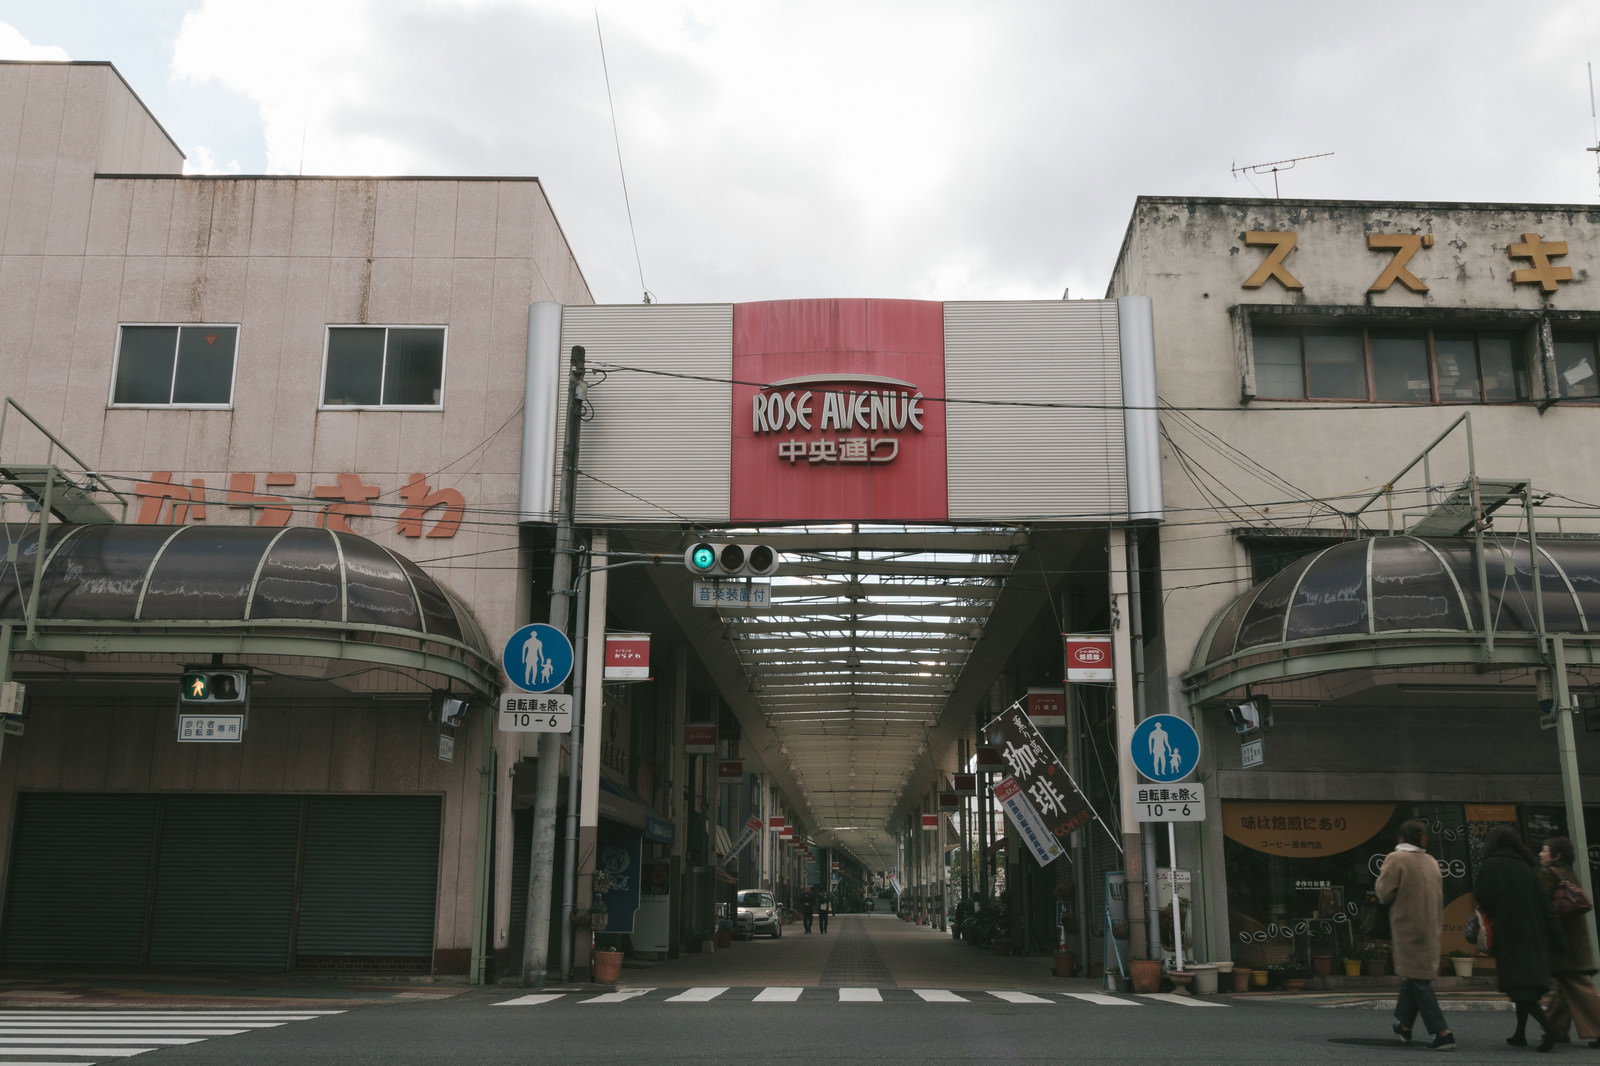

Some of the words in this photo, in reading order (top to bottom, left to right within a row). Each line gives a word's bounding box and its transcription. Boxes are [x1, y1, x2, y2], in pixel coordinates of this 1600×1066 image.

[1242, 231, 1573, 292] スズキ
[753, 390, 813, 433] ROSE
[820, 390, 924, 431] AVENUE
[778, 437, 899, 463] 中央通り
[135, 471, 465, 538] からさわ
[506, 699, 566, 712] 自転車を除く
[1002, 741, 1067, 817] 珈琲
[1138, 788, 1198, 801] 自転車を除く
[1241, 815, 1347, 832] 味は焙煎にあり
